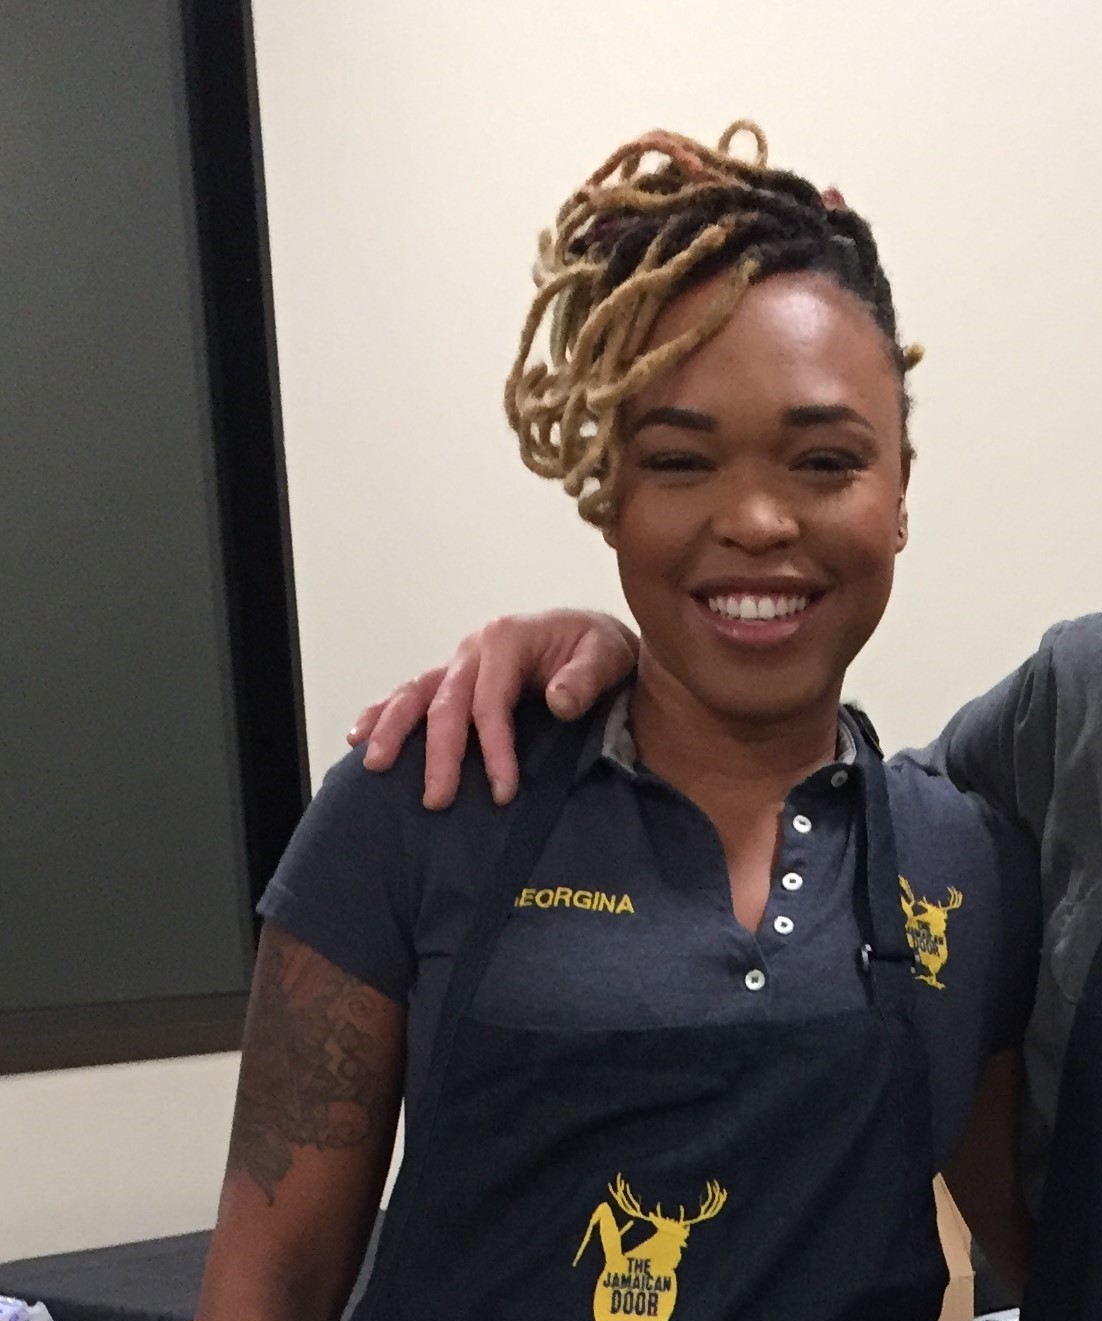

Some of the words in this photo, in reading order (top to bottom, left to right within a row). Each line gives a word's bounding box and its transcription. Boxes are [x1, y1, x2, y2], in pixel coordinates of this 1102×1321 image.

[514, 886, 635, 914] EORGINA
[627, 1257, 651, 1274] THE
[602, 1273, 671, 1293] JAMAICAN
[610, 1290, 659, 1317] DOOR
